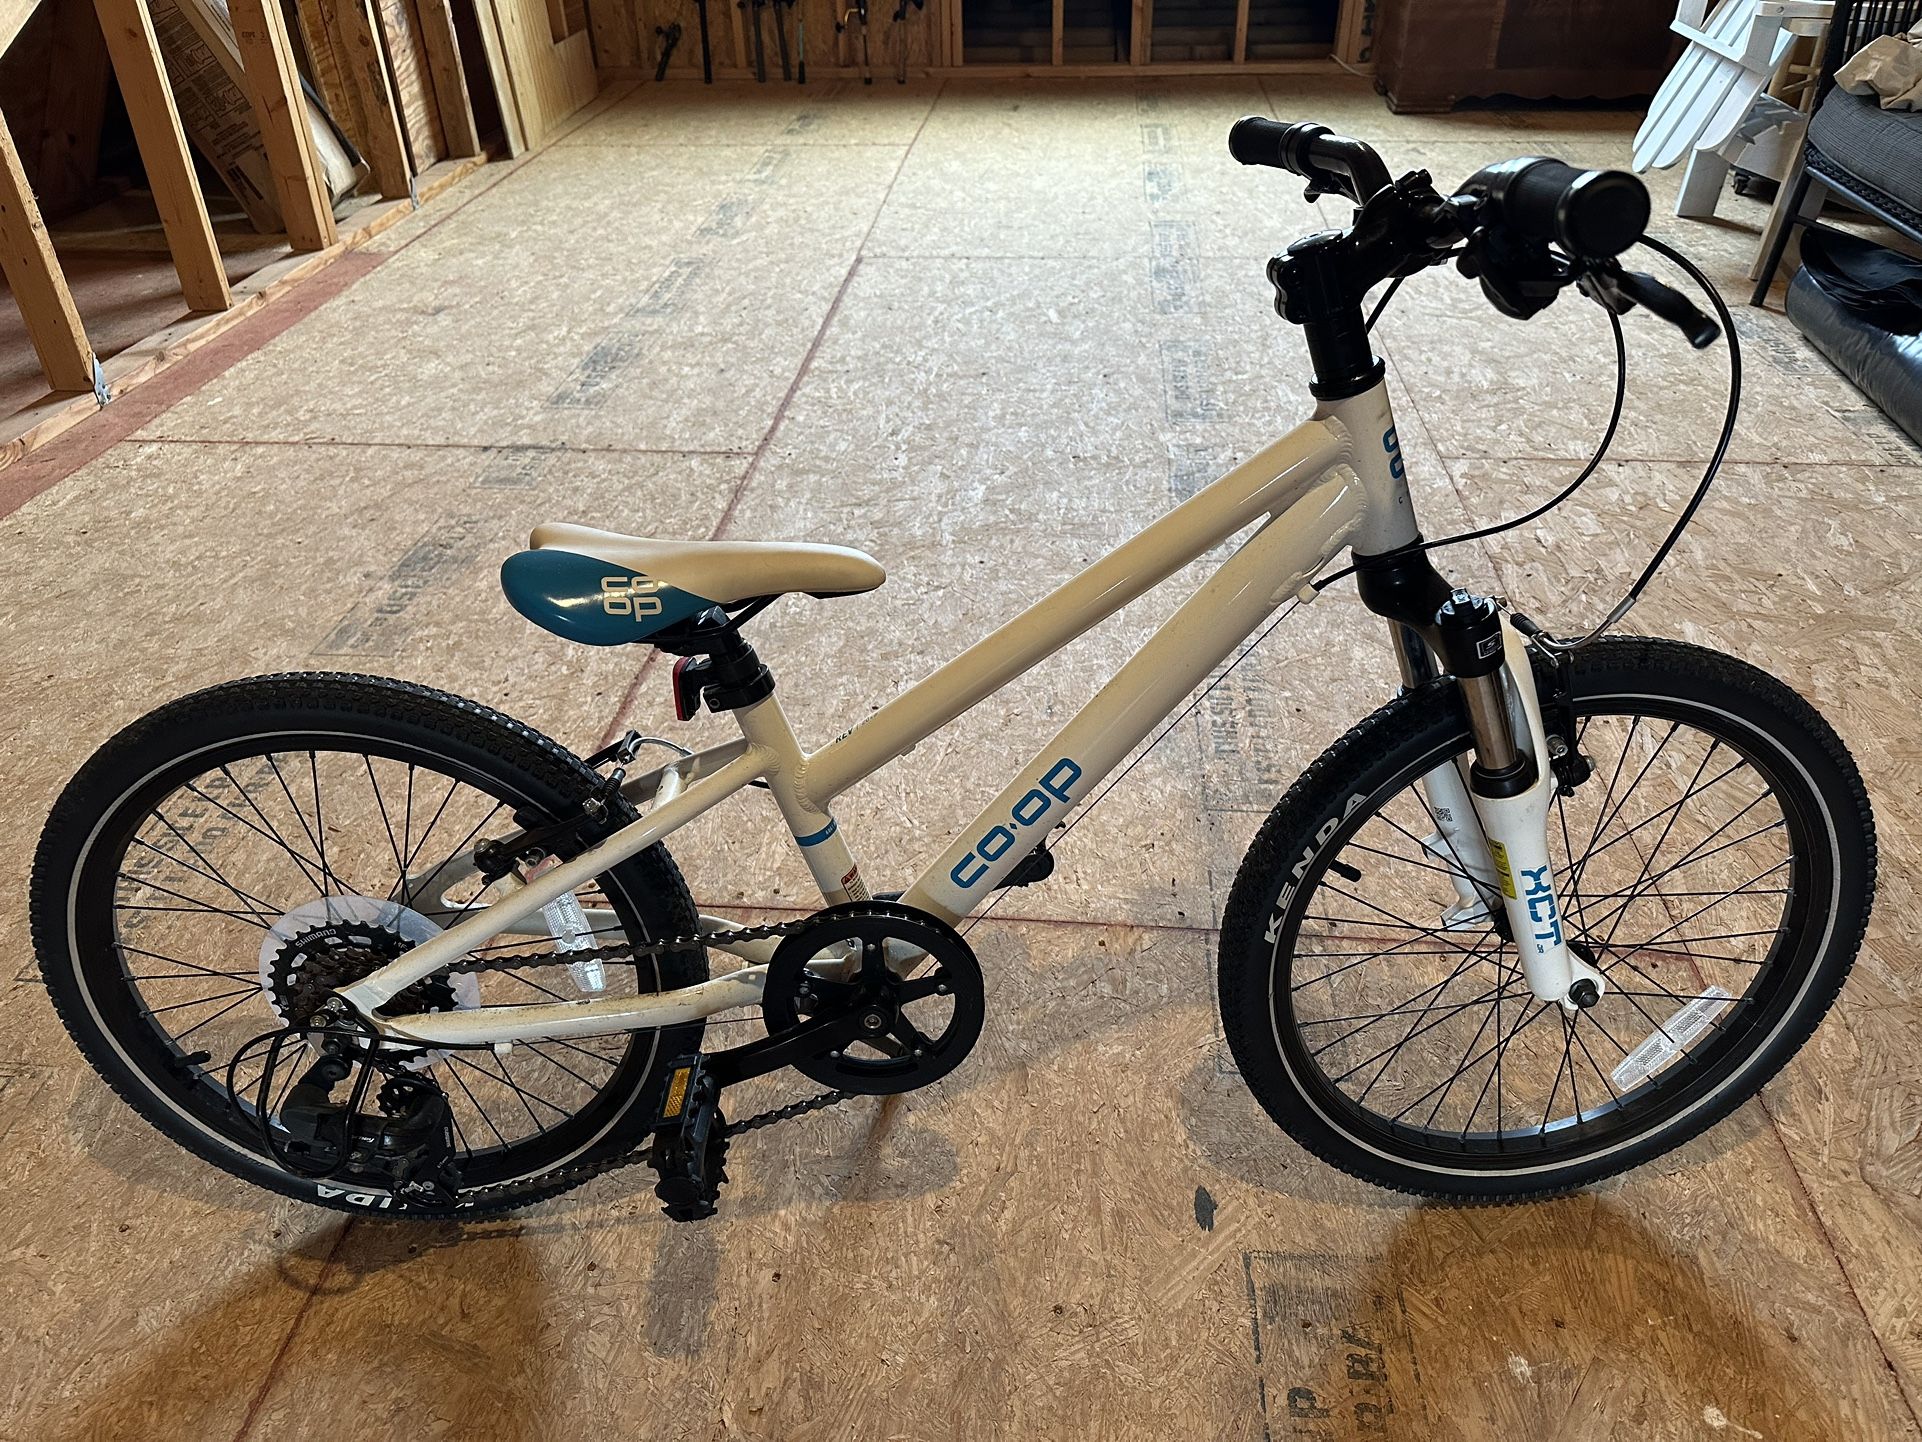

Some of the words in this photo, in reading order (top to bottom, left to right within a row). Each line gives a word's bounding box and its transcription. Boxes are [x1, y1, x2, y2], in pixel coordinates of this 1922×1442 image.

[1263, 793, 1367, 944] KENDA
[1520, 865, 1562, 946] XCT
[295, 928, 337, 948] SHIMANO
